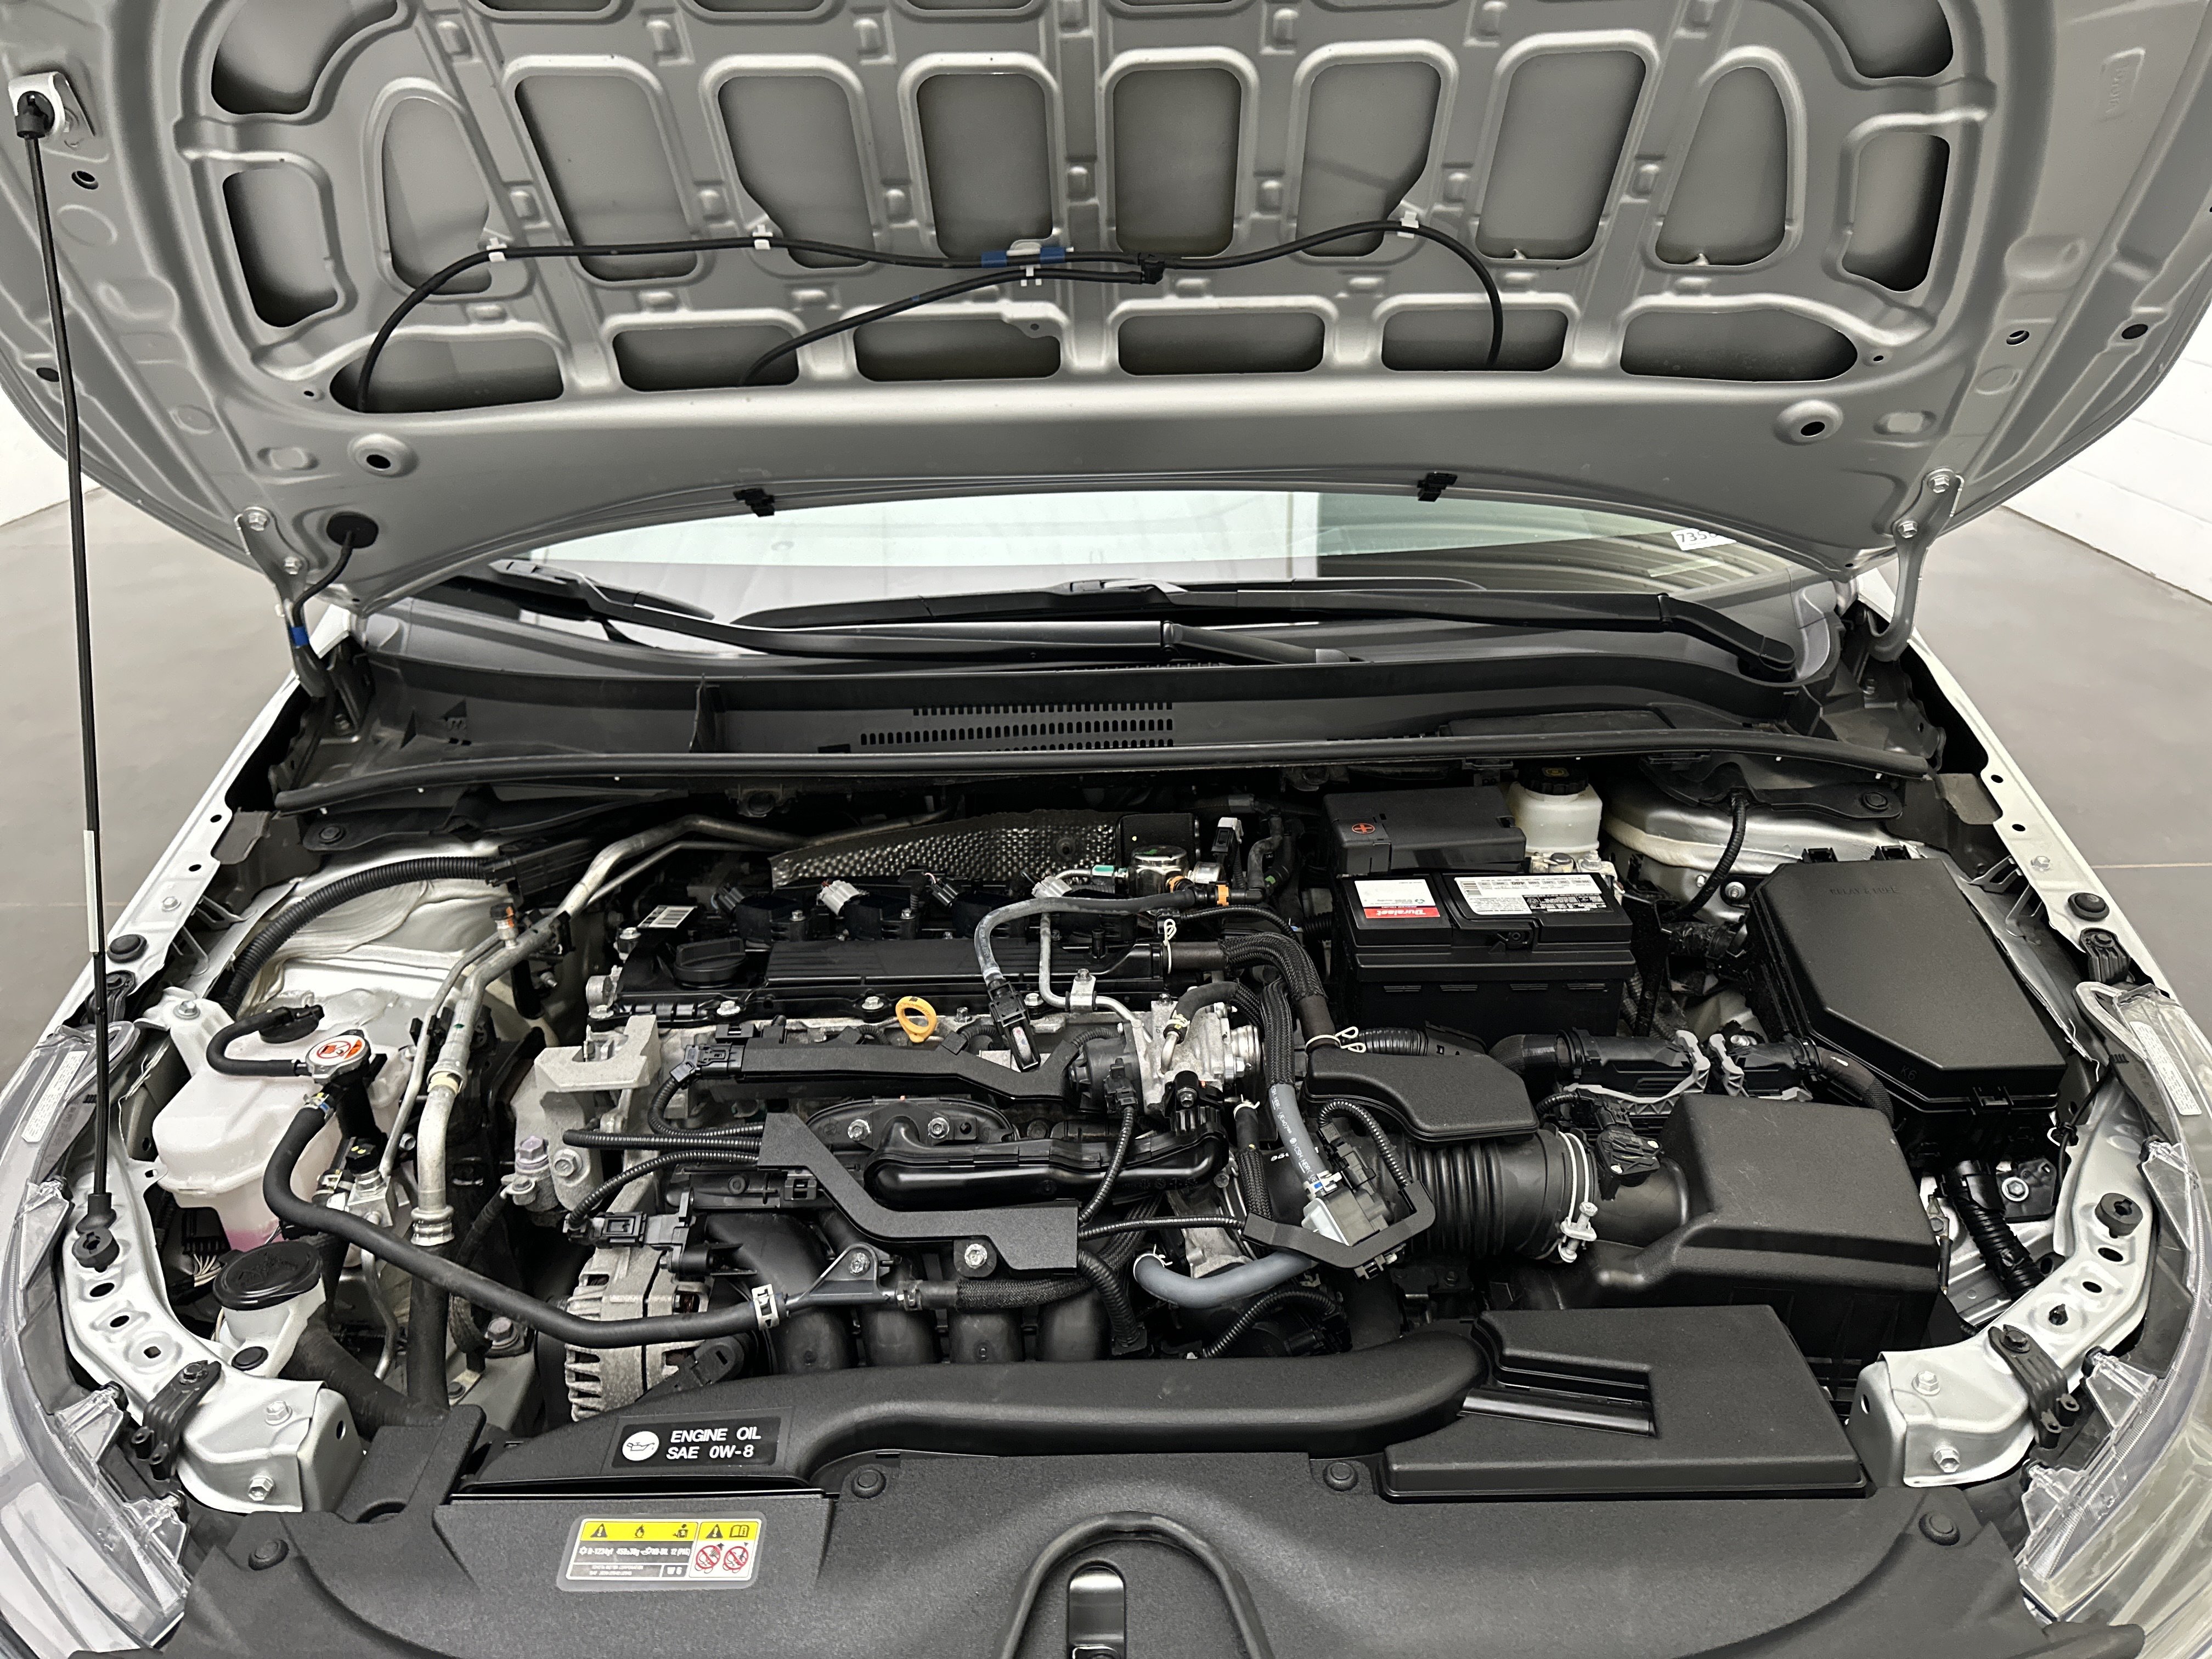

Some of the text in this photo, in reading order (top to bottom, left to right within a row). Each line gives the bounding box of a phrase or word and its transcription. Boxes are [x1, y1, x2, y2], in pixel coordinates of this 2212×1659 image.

[1900, 1065, 1918, 1081] K6
[670, 1426, 761, 1443] ENGINE OIL
[665, 1444, 754, 1460] SAE 0W-8
